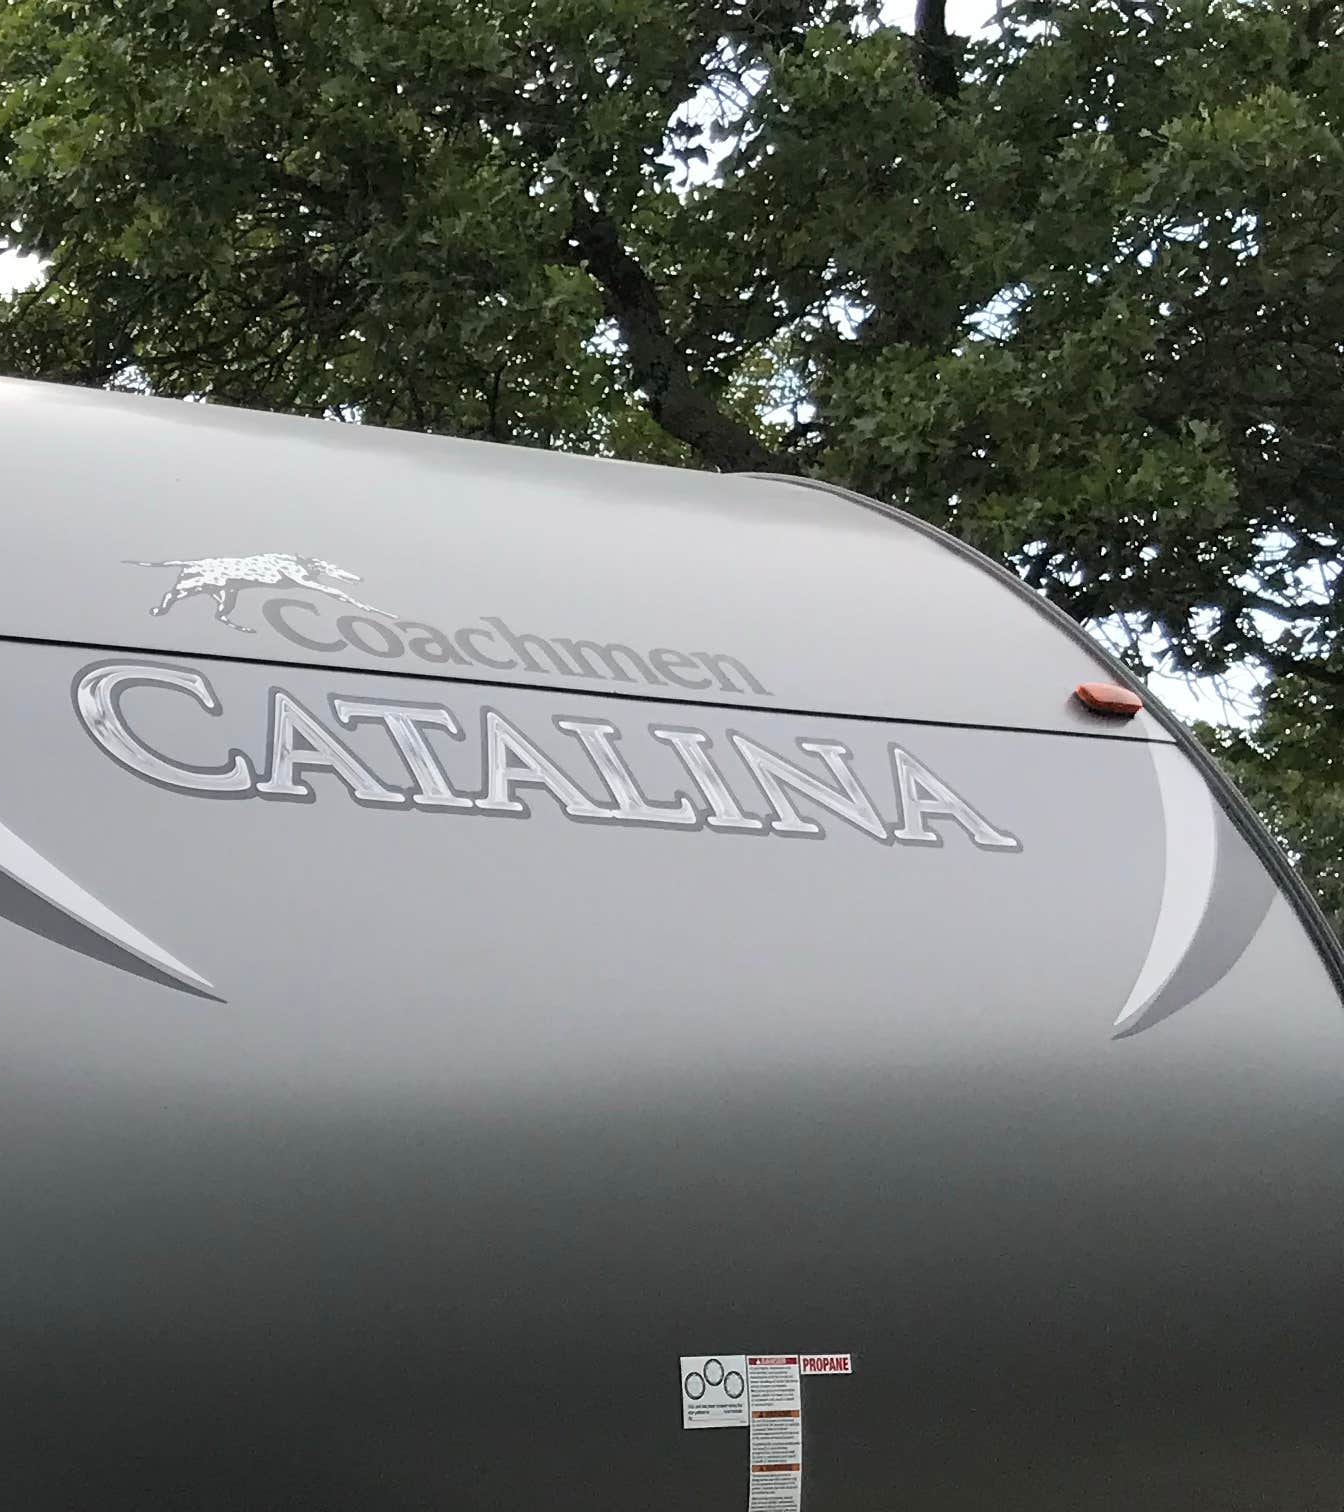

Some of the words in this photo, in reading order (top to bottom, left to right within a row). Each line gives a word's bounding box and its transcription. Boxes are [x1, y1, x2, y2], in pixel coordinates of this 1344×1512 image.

[262, 598, 774, 696] Coachmen
[71, 658, 1023, 851] CATALINA
[802, 1357, 849, 1372] PROPANE
